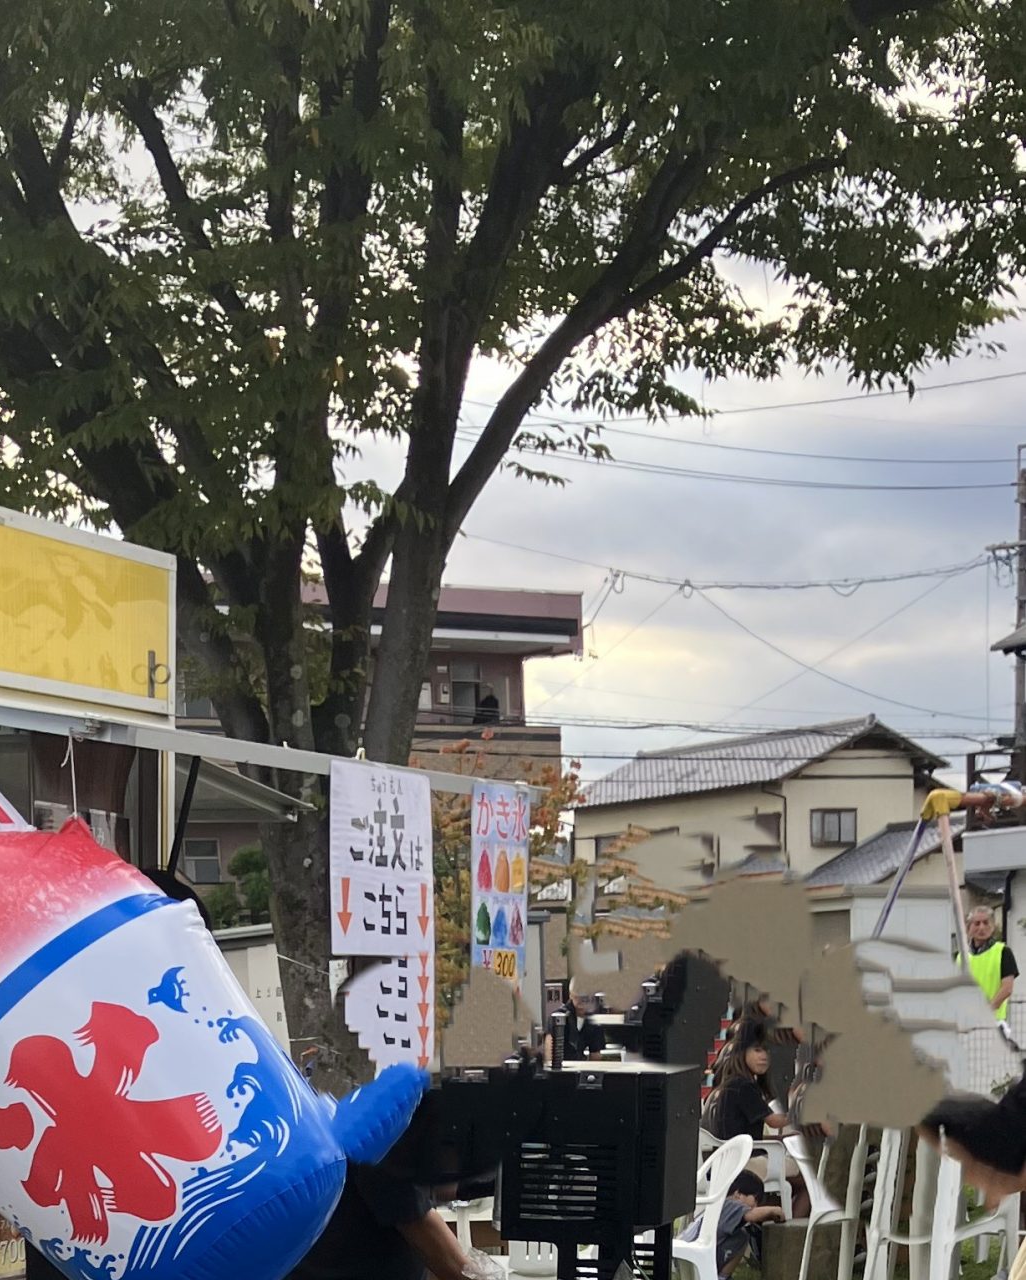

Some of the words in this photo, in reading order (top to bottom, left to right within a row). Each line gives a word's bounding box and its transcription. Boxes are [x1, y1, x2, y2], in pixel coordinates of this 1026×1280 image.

[350, 796, 424, 872] ご注文は
[476, 792, 527, 842] かき氷
[363, 882, 408, 935] こちら
